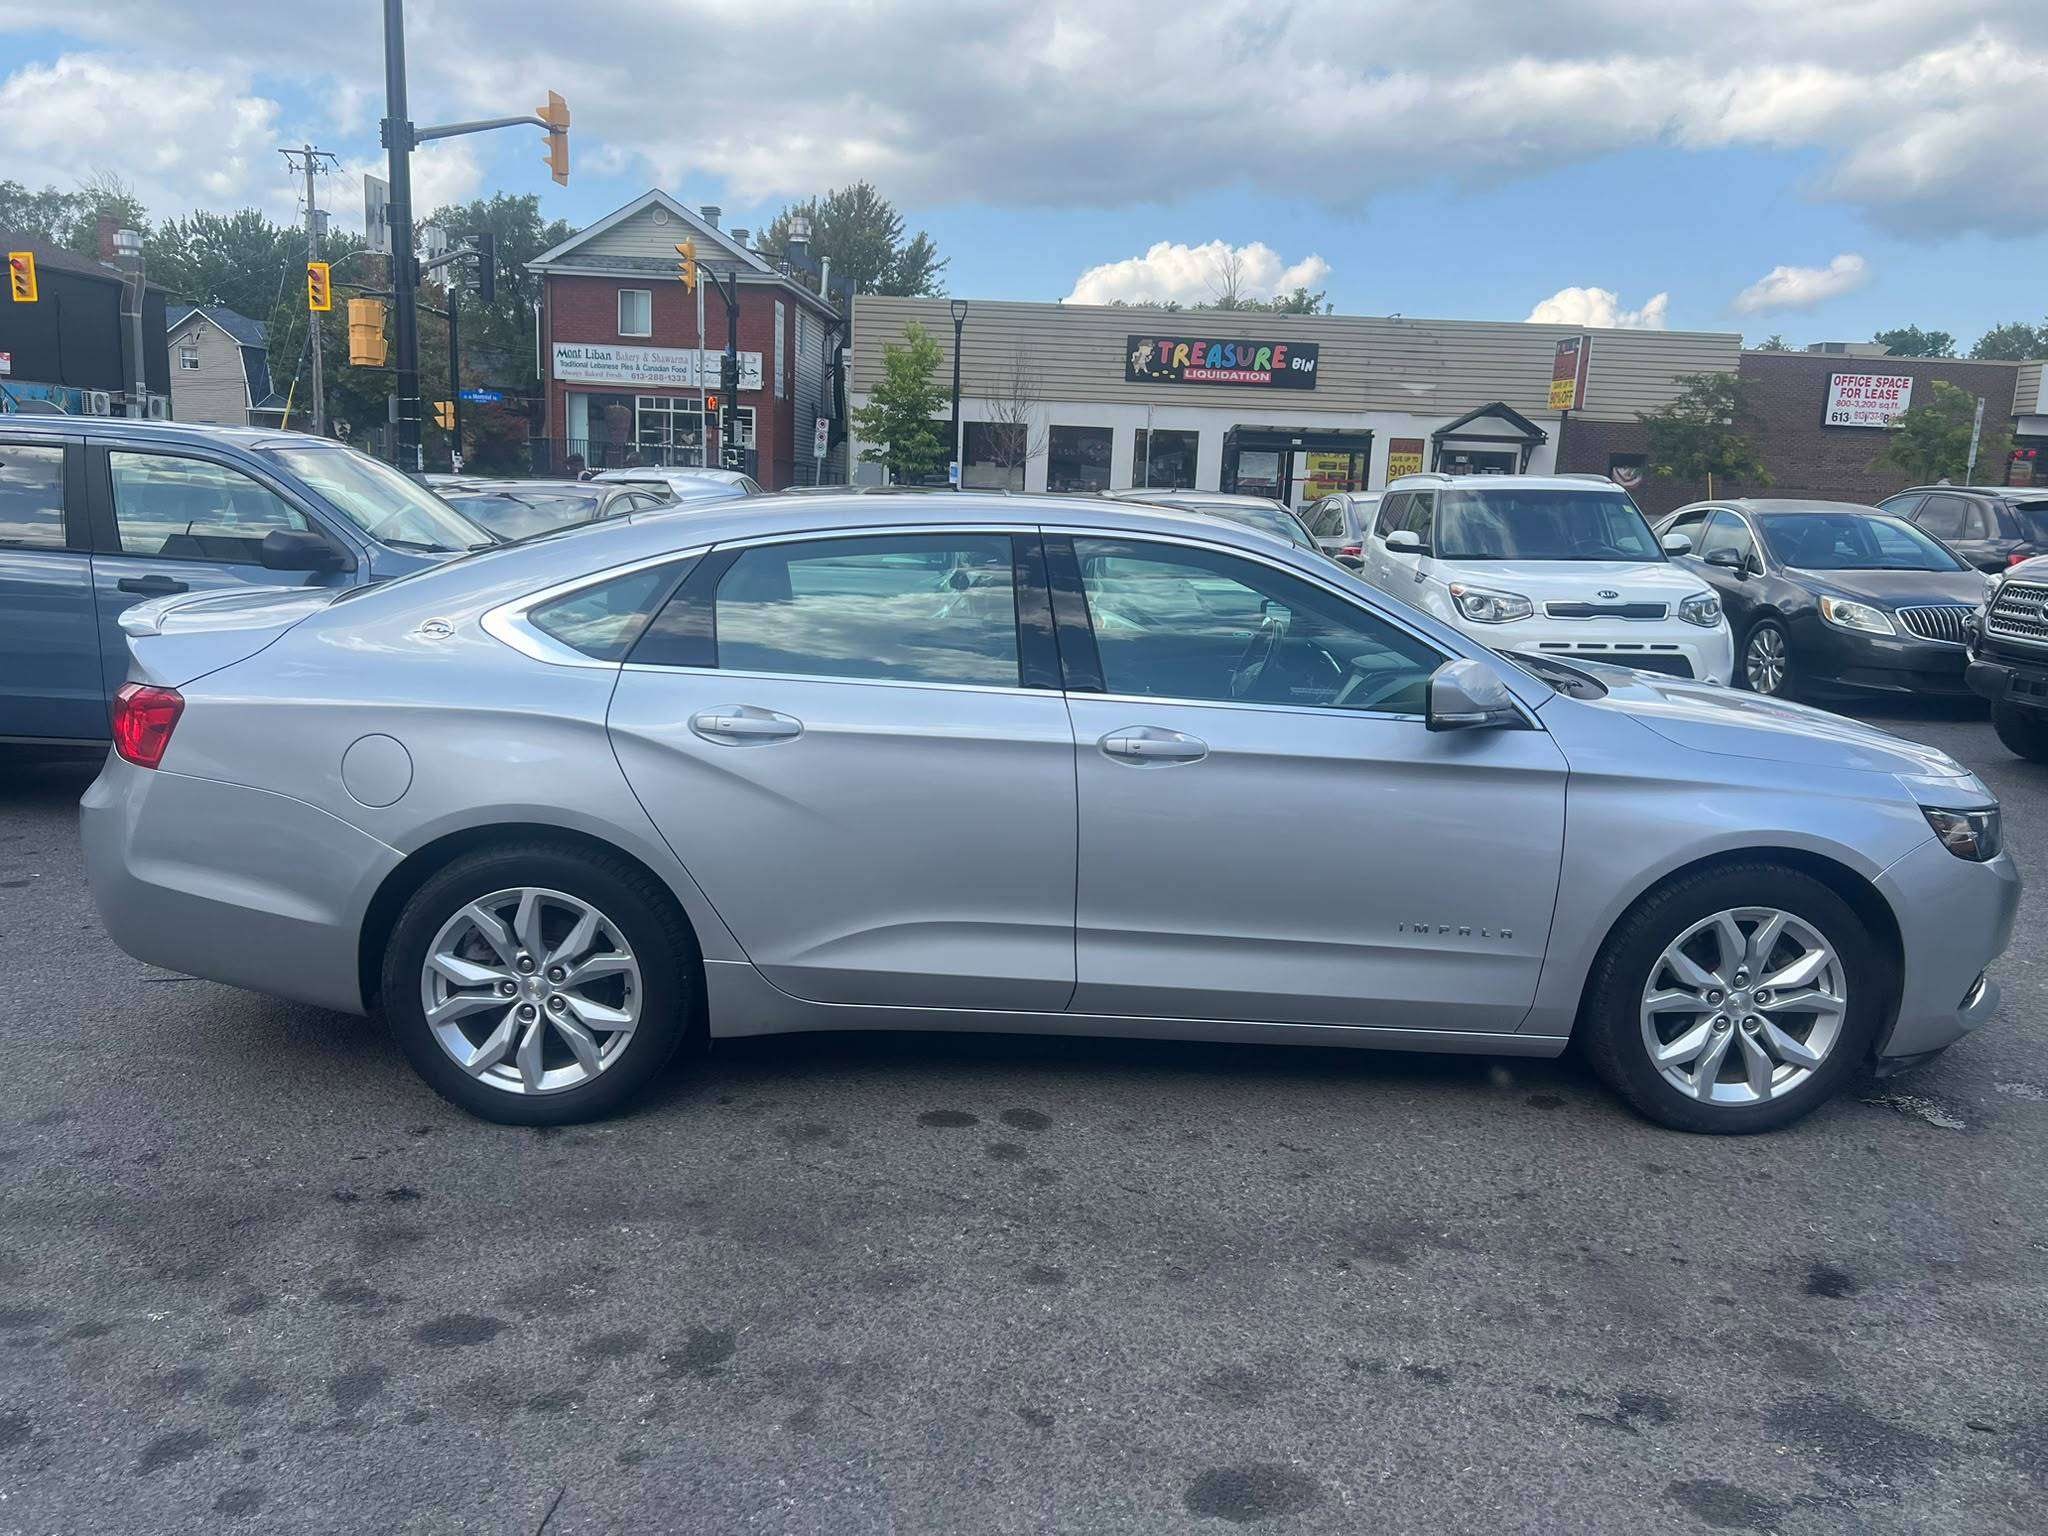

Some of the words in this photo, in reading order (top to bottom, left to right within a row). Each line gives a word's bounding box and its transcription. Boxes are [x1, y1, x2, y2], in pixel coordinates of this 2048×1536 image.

[556, 348, 581, 358] Mont
[586, 349, 611, 360] Liban
[615, 351, 639, 362] Bakery
[1158, 340, 1288, 371] TREASURE
[560, 360, 588, 368] Traditional
[590, 362, 618, 370] Lebanese
[642, 364, 669, 372] Canadian
[1185, 370, 1270, 381] LIQUIDATION
[1834, 375, 1872, 387] OFFICE
[1875, 377, 1910, 388] SPACE
[1840, 388, 1861, 399] FOR
[1864, 389, 1899, 400] LEASE
[1835, 400, 1877, 408] 800-3,200
[1390, 464, 1418, 476] 90%
[1599, 590, 1617, 598] KIA
[1399, 921, 1513, 940] IMPALA
